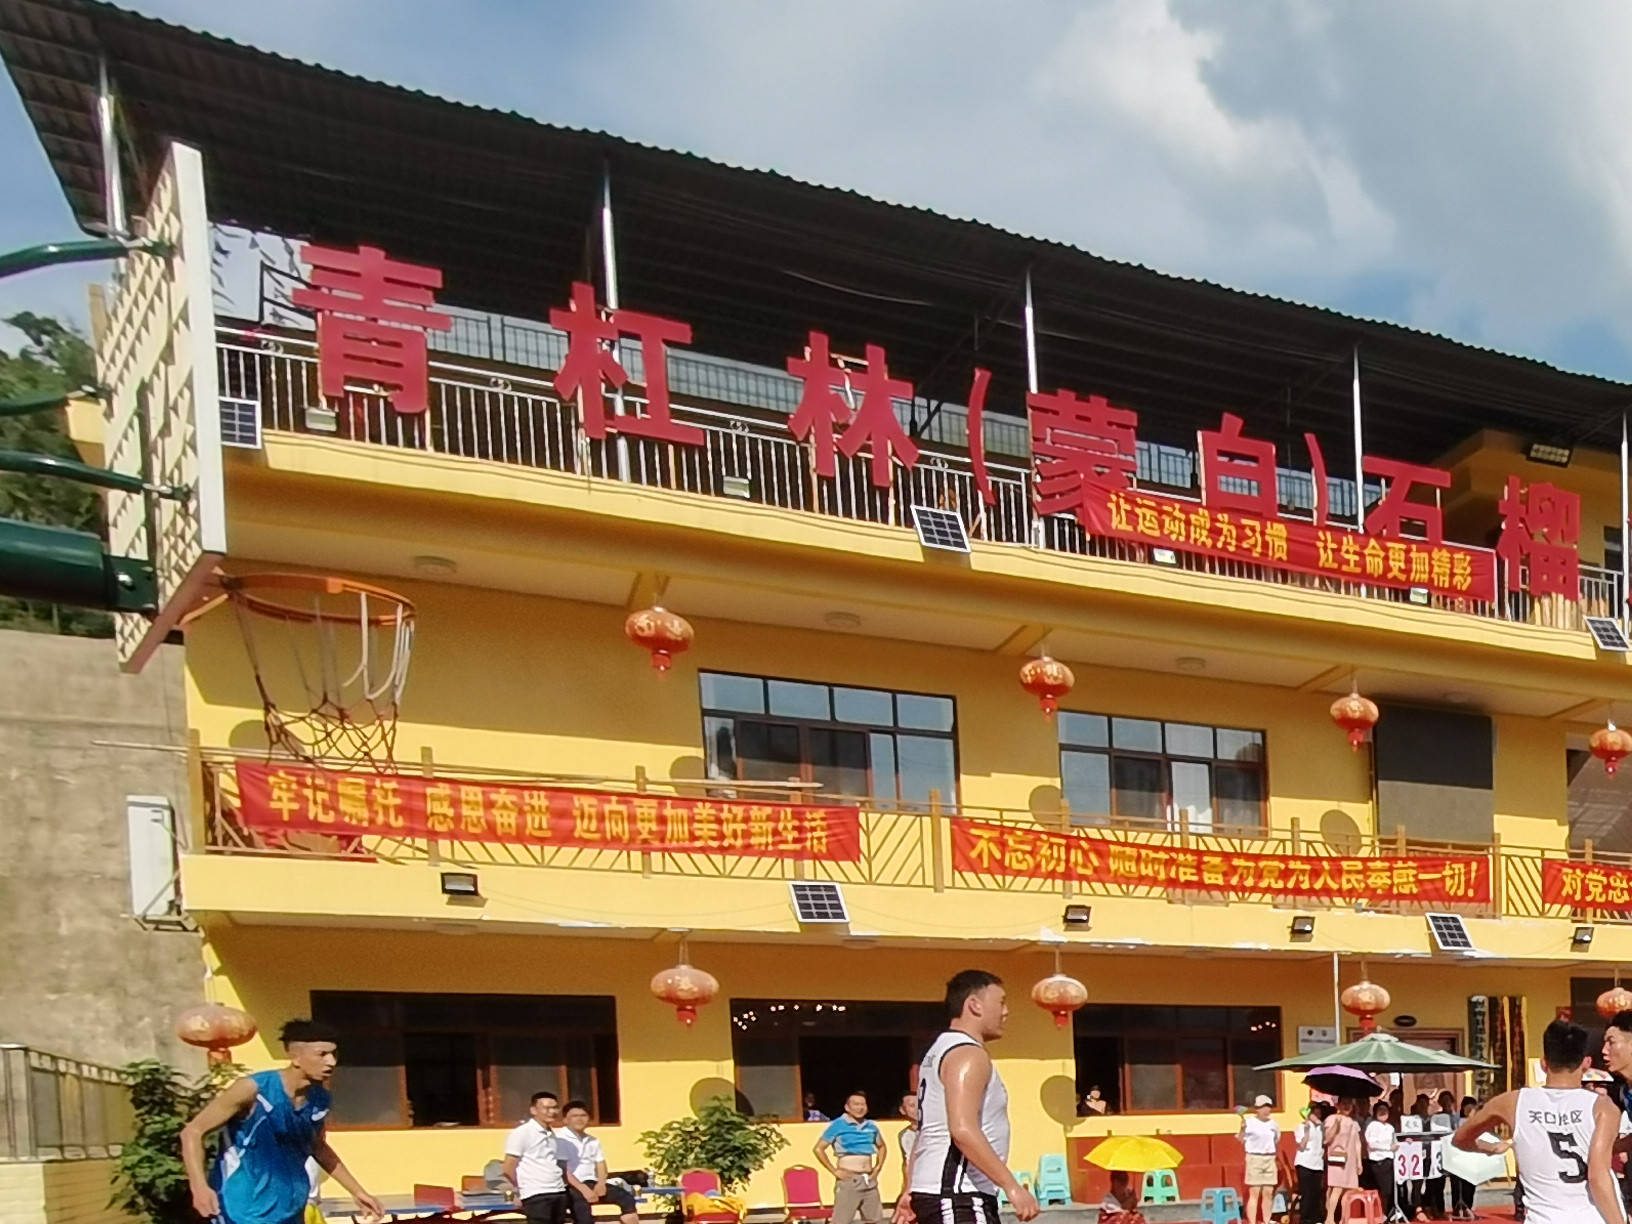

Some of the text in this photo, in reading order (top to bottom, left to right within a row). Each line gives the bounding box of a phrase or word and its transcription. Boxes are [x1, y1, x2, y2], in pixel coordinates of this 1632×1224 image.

[1107, 491, 1472, 591] 让运动成为习惯 让生命更加精彩
[268, 770, 828, 854] 牢记嘱托 感恩奋进 迈向更加美好新生活
[968, 828, 1100, 875] 不忘初心
[1398, 1154, 1421, 1176] 32
[1547, 1131, 1588, 1183] 5
